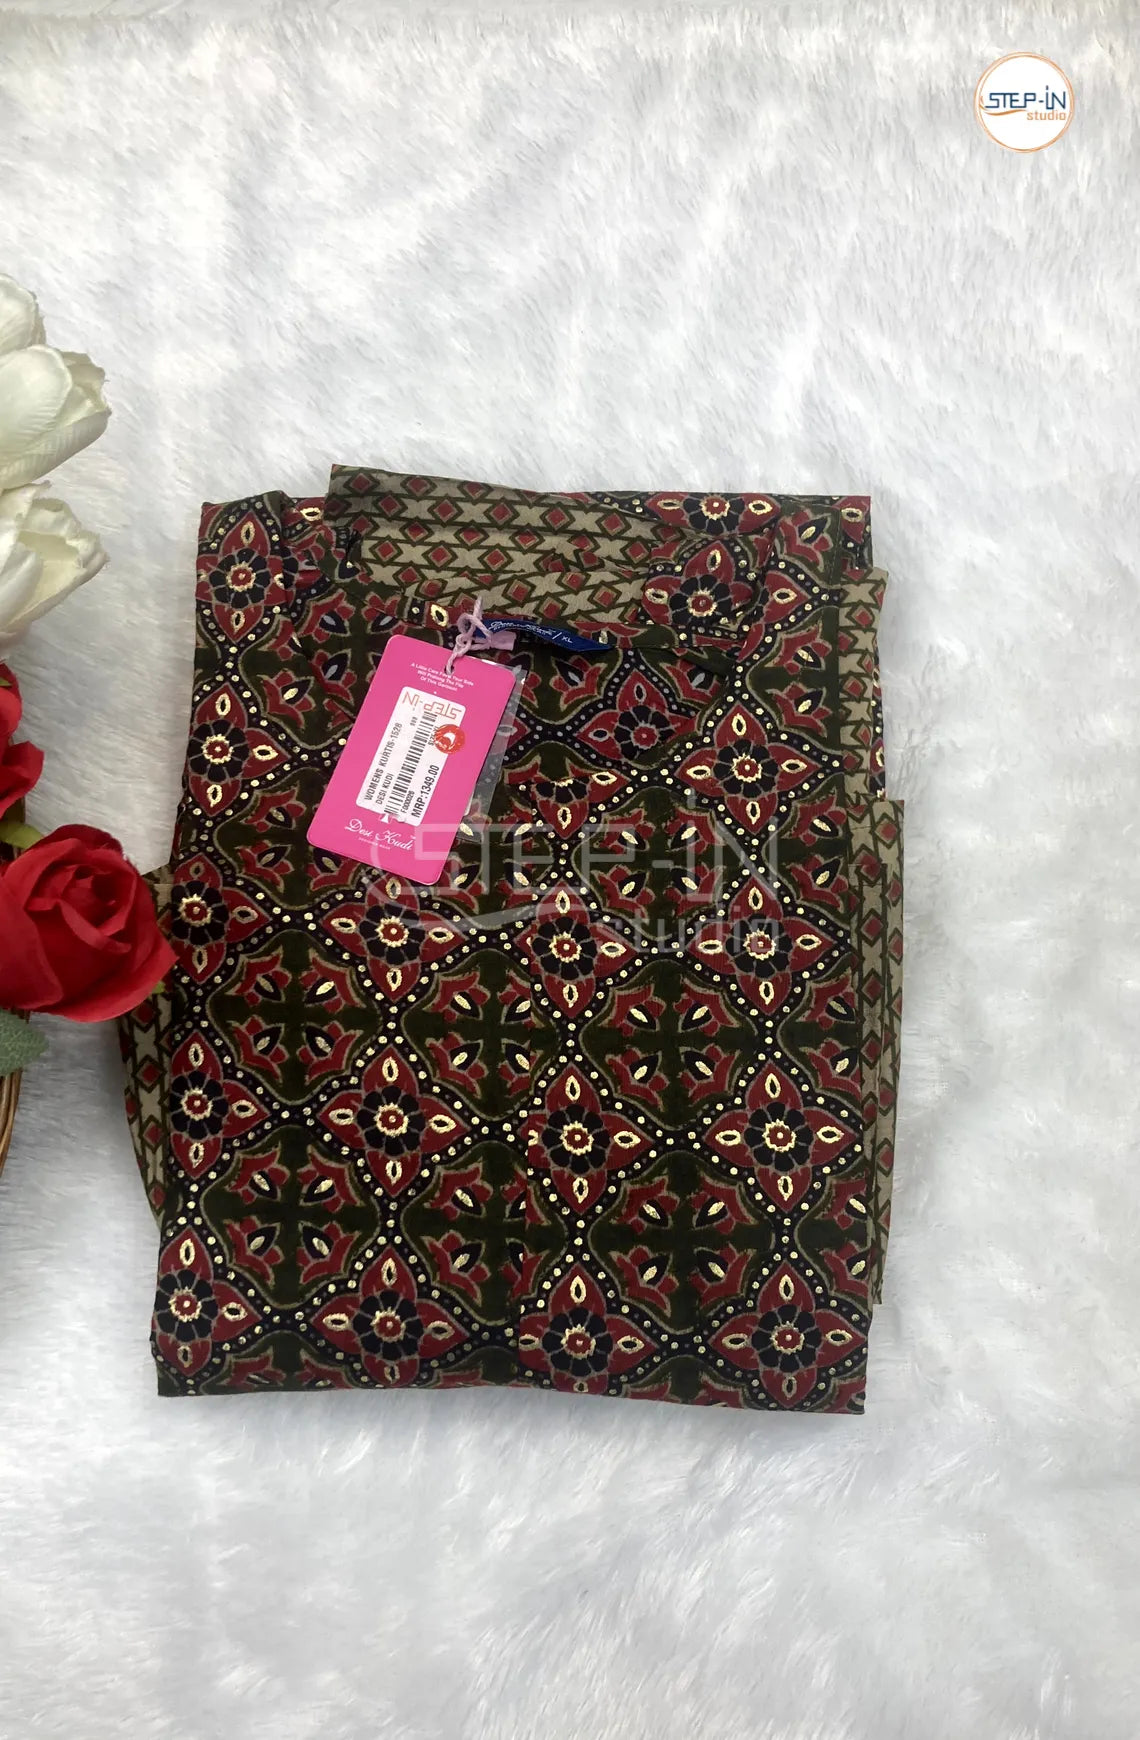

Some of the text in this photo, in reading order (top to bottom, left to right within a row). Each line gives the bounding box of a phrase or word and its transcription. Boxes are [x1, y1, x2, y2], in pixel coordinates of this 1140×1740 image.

[364, 722, 403, 801] WOMENS KURTIS-1528
[375, 773, 394, 805] DESI KUDI
[411, 764, 440, 818] MRP:1349.00
[344, 818, 413, 850] Desi Kudi
